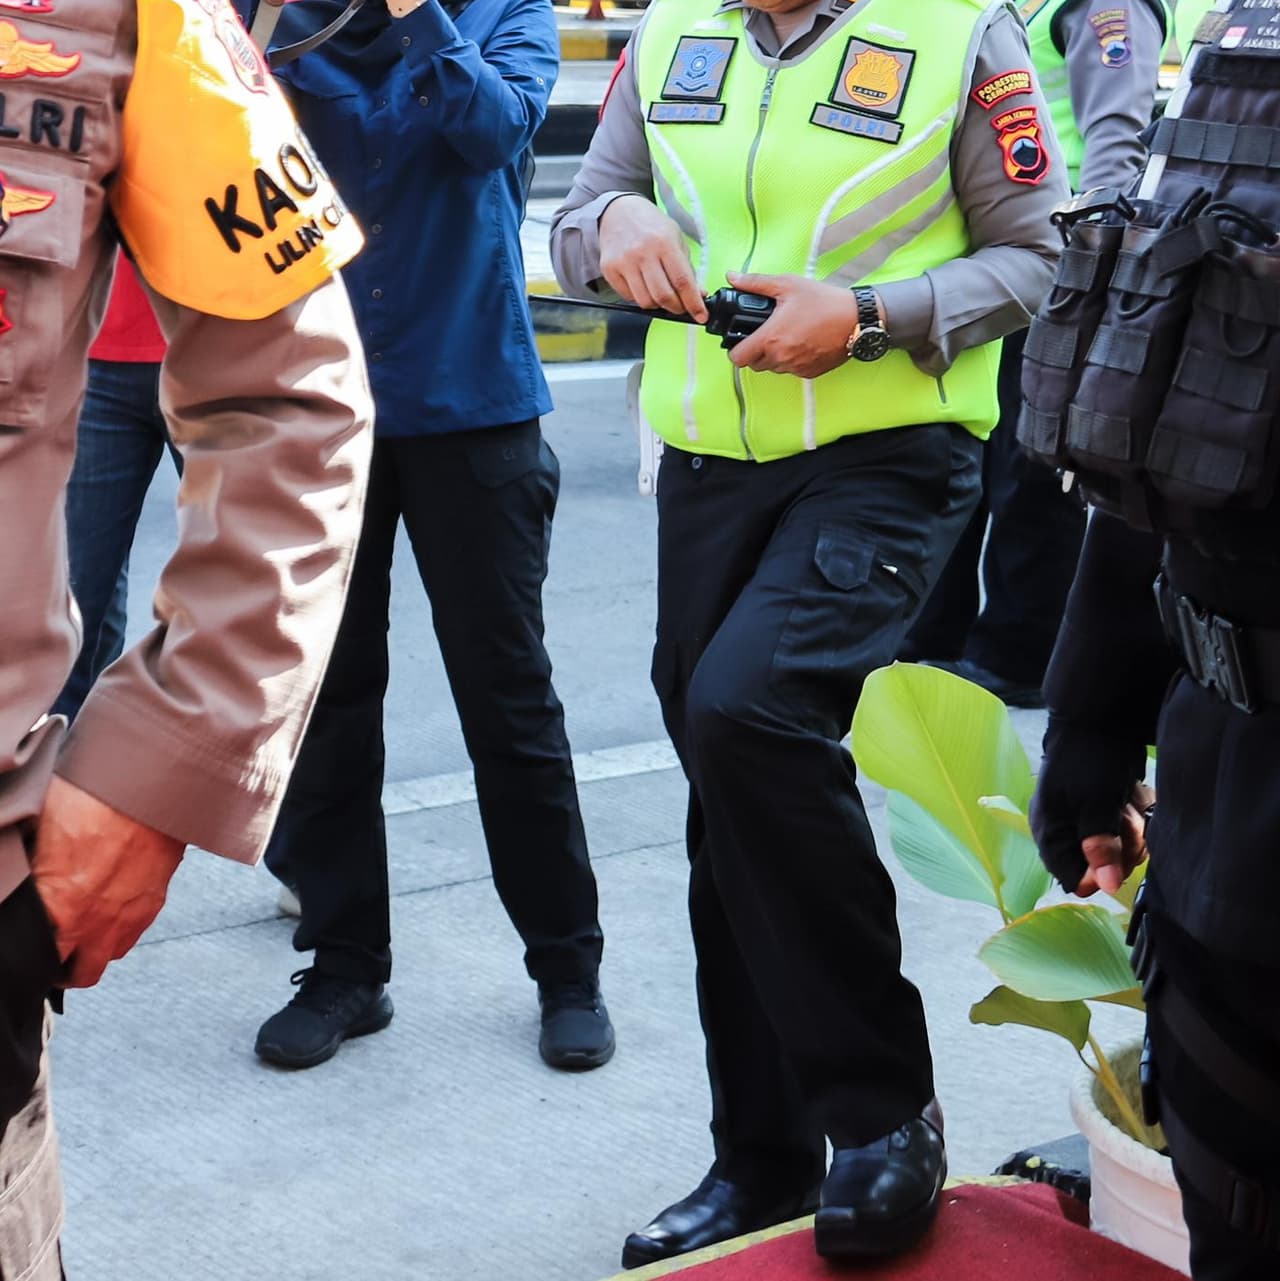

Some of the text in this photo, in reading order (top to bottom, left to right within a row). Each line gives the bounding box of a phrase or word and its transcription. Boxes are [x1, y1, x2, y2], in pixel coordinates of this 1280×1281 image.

[827, 111, 886, 136] POLRI
[204, 124, 328, 253] KAO
[264, 219, 324, 274] LILIN
